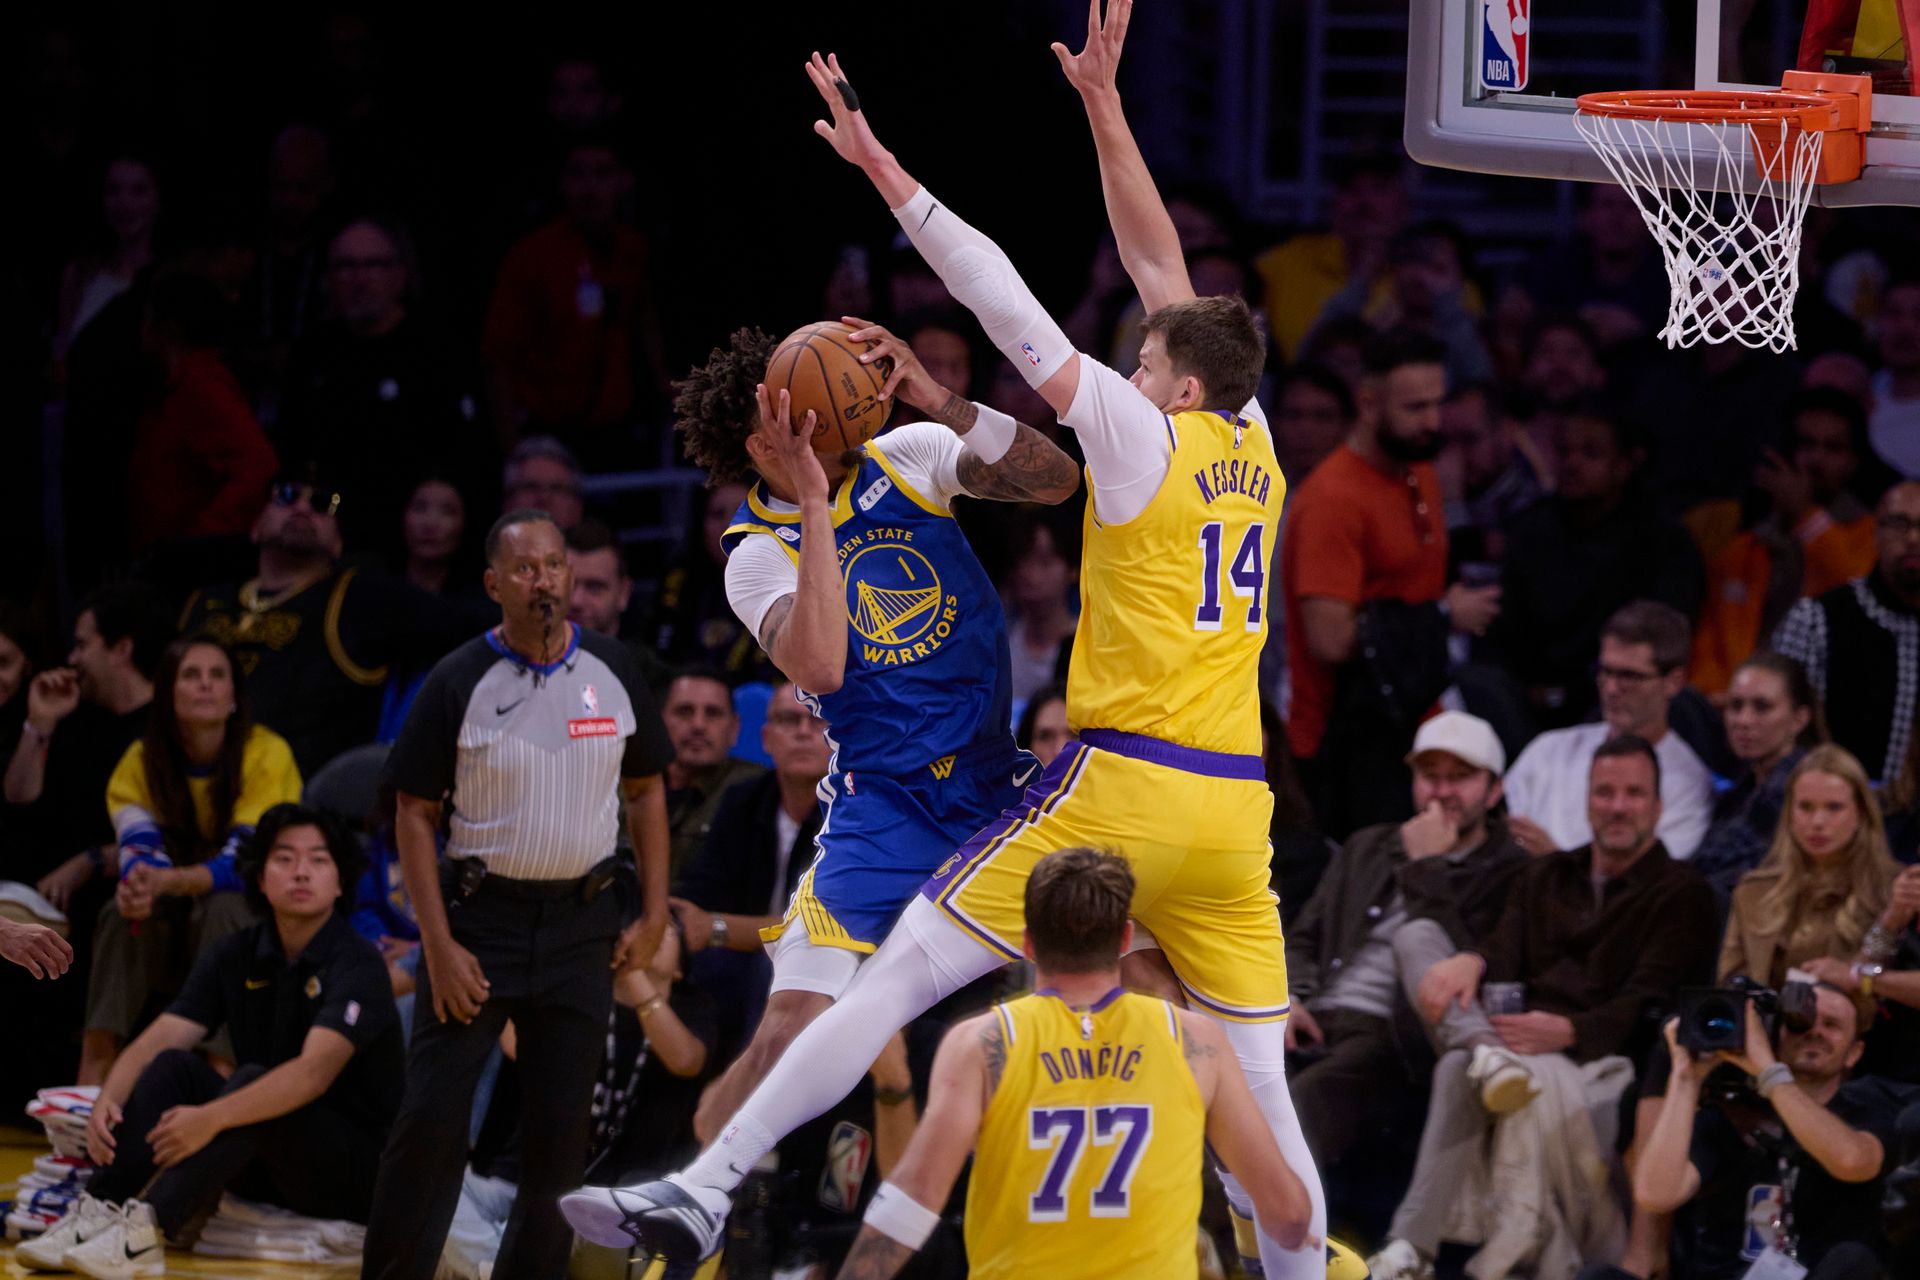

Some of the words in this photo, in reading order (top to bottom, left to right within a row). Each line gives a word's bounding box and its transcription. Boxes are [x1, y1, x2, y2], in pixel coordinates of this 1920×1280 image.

[1487, 59, 1510, 82] NBA
[1194, 459, 1271, 507] KESSLER
[866, 527, 914, 542] STATE
[1194, 521, 1265, 632] 14
[863, 594, 958, 665] WARRIORS
[569, 720, 617, 736] Emirates
[1041, 1041, 1145, 1084] DONČIĆ
[1028, 1104, 1154, 1223] 77
